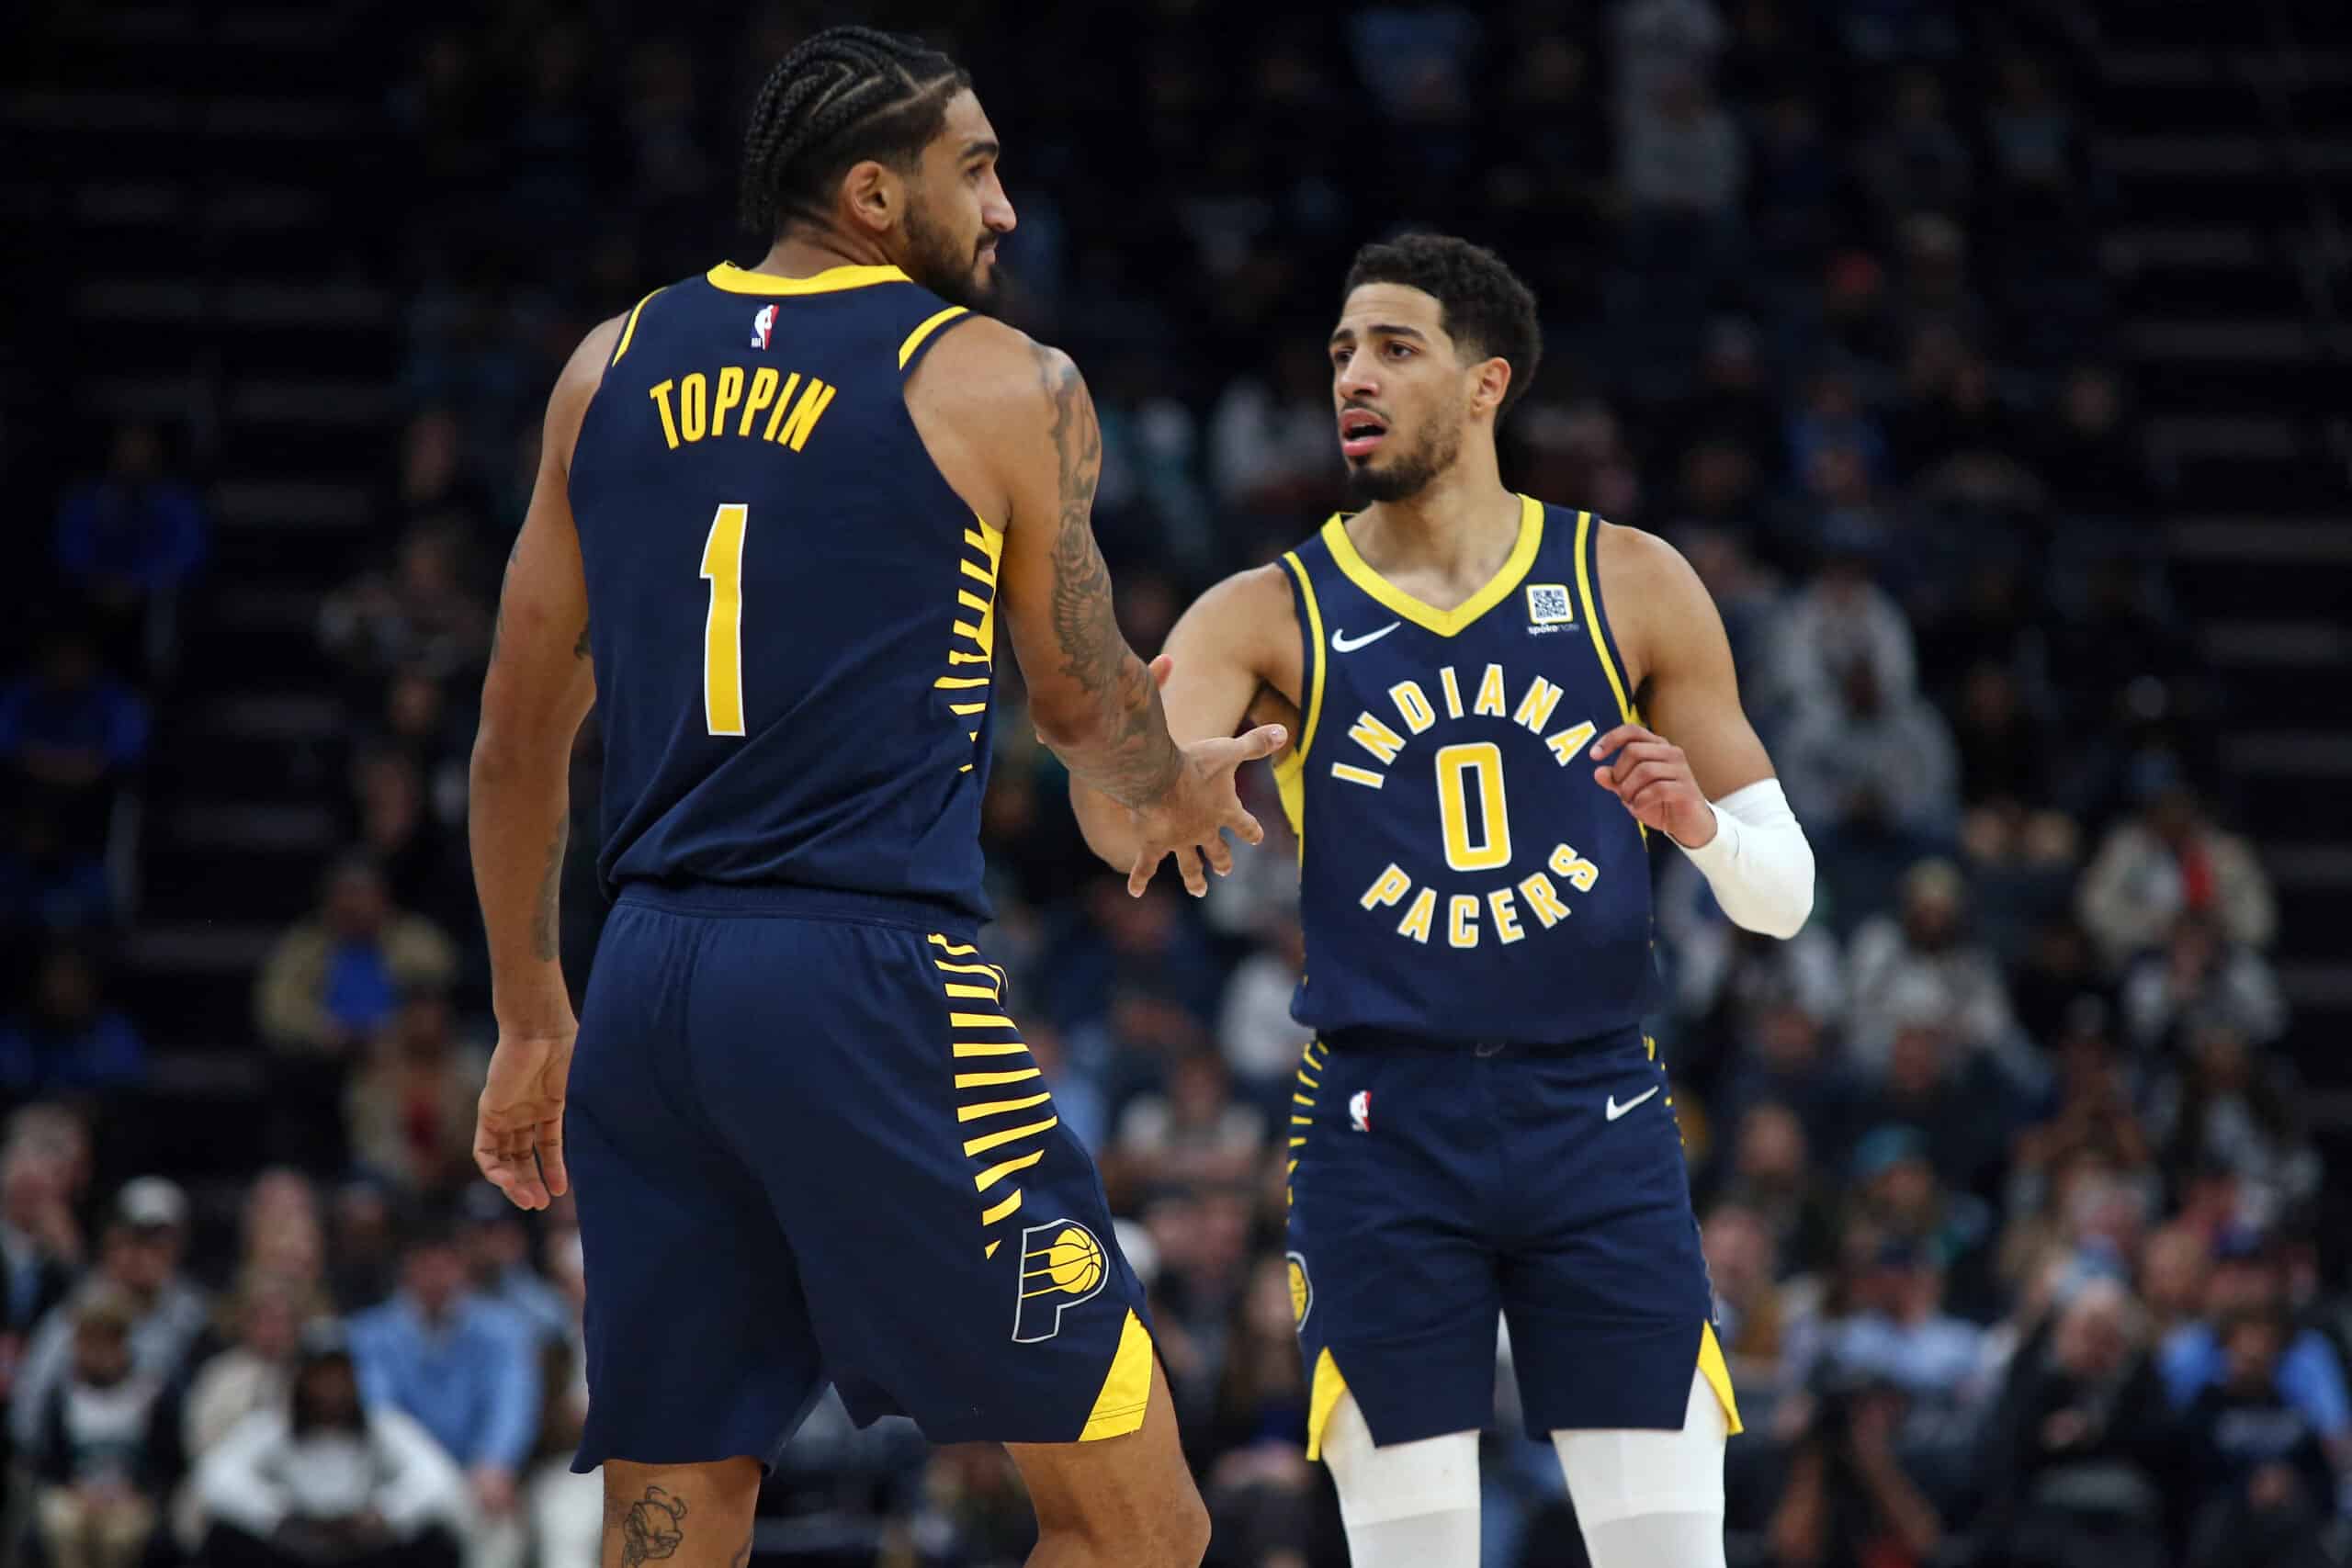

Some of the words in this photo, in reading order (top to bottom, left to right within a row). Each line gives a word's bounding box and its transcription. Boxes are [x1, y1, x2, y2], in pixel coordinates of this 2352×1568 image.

[650, 367, 836, 452] TOPPIN
[700, 503, 748, 736] 1
[1331, 663, 1597, 789] INDIANA
[1435, 741, 1512, 872] 0
[1360, 842, 1599, 948] PACERS
